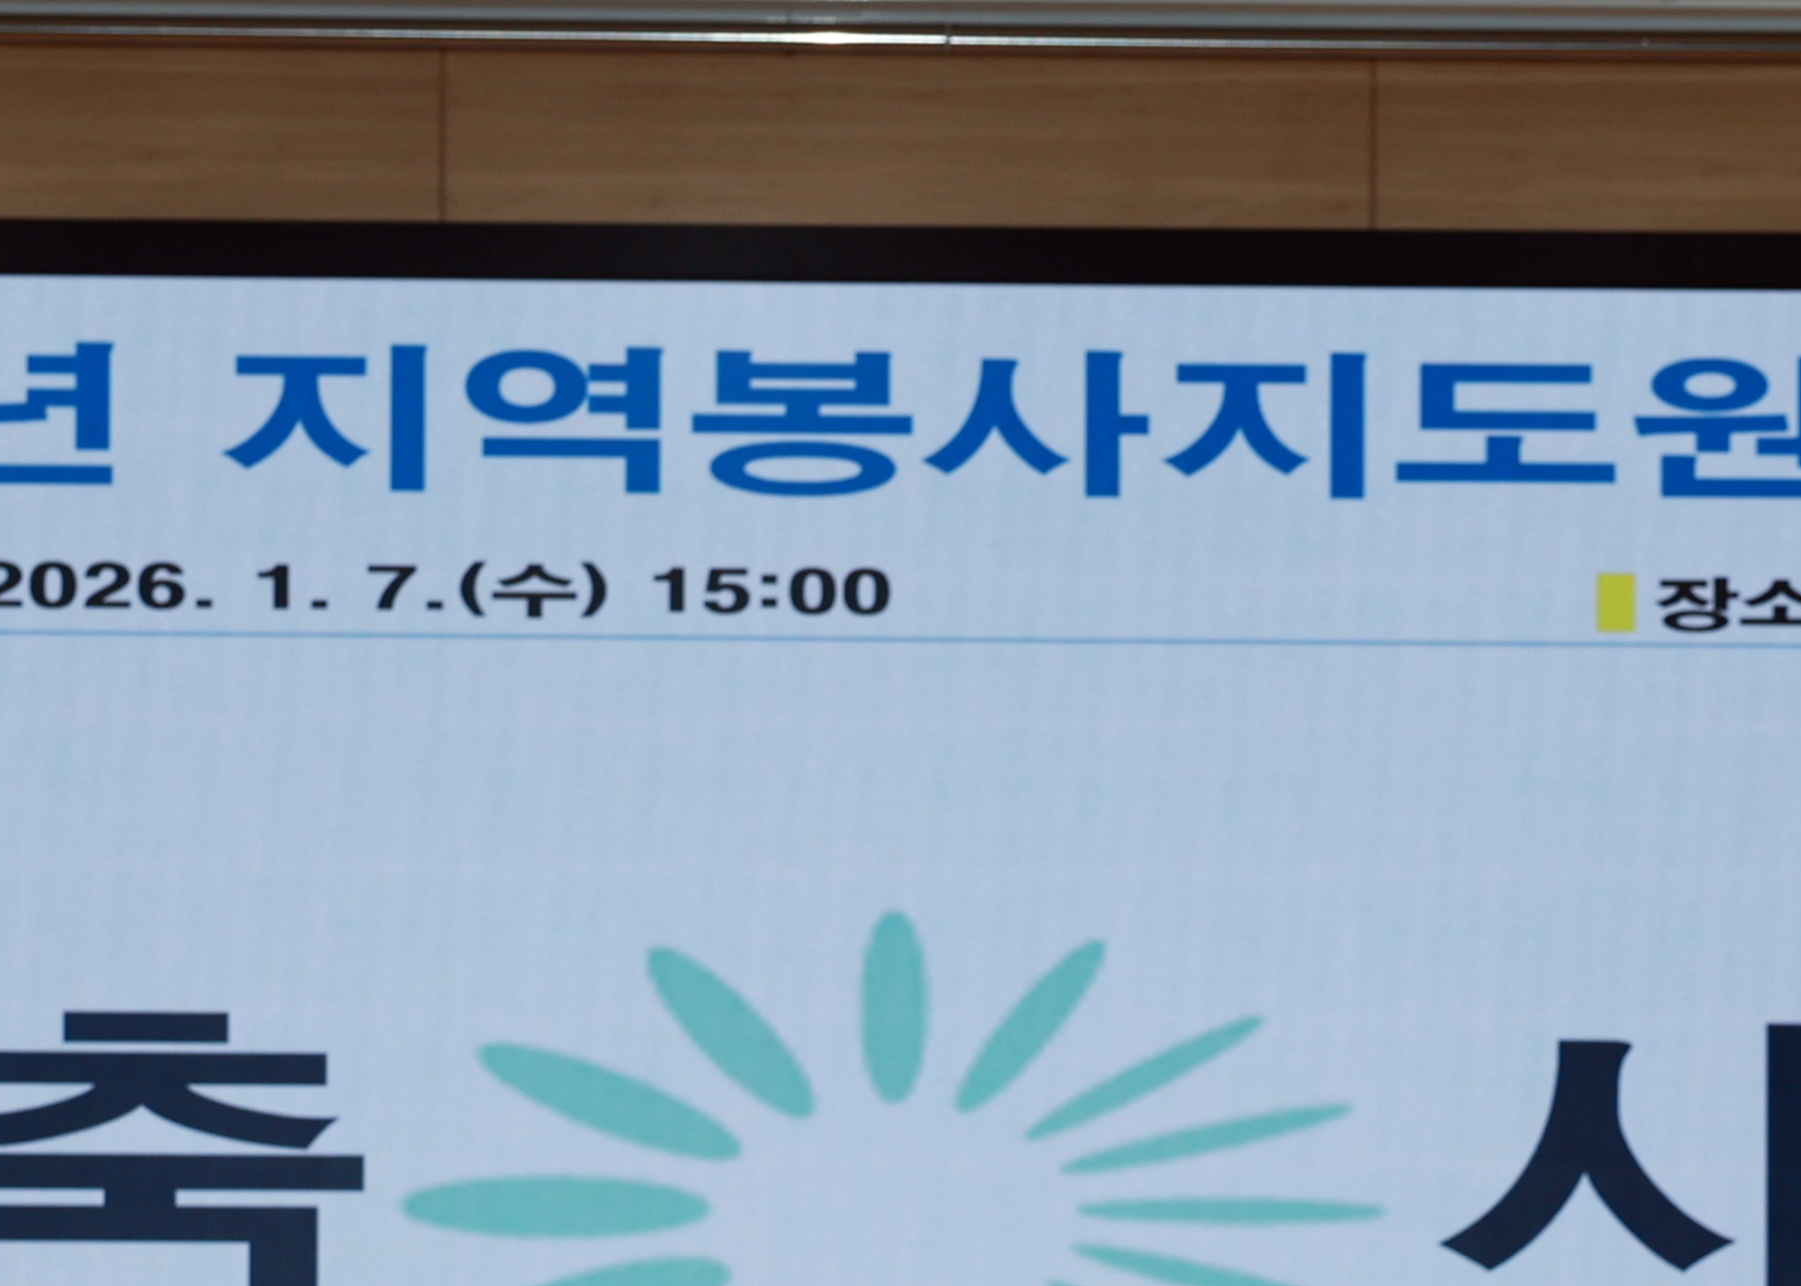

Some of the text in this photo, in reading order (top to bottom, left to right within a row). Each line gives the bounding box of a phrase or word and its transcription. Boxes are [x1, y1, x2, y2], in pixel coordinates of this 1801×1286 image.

[257, 563, 328, 610] 1.
[367, 560, 608, 618] 7.(수)
[653, 566, 891, 616] 15:00
